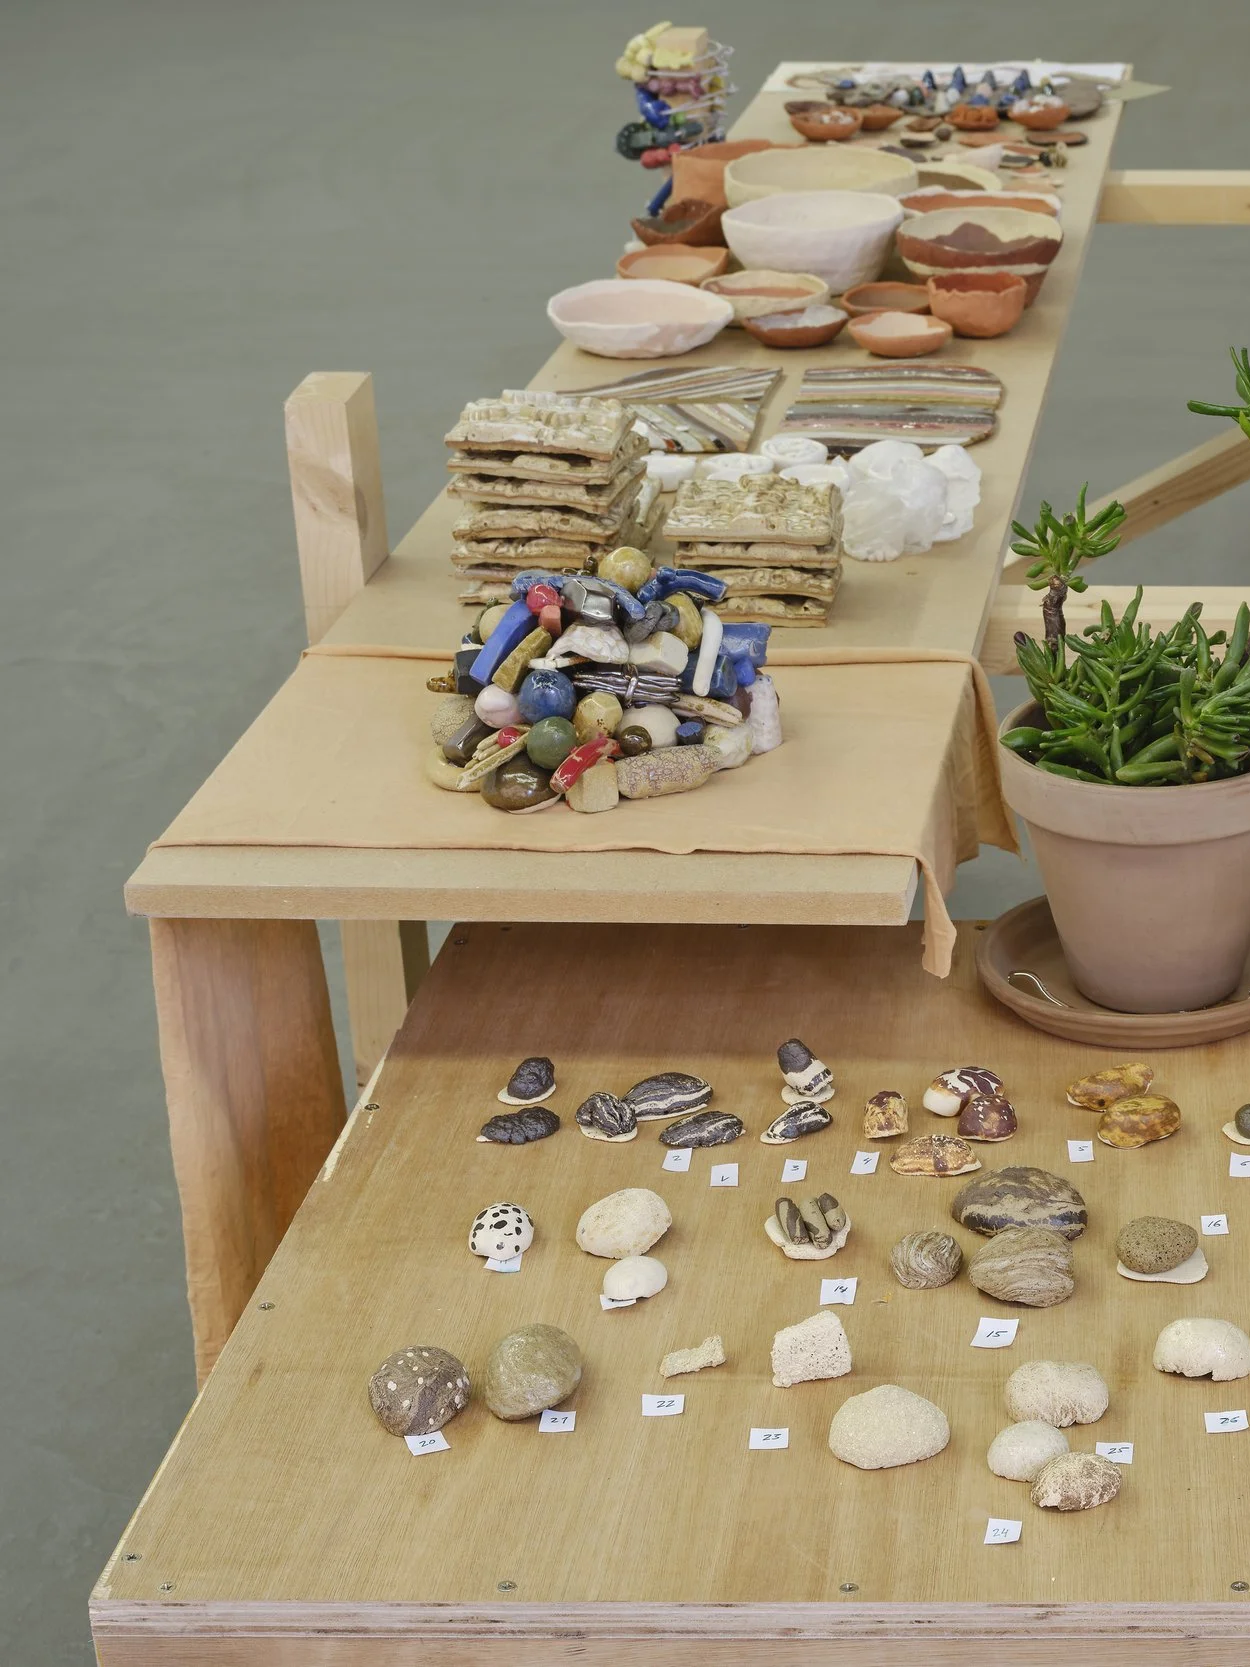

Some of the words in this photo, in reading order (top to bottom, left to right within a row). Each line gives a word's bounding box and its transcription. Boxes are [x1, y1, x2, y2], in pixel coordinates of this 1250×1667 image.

[1208, 1219, 1222, 1228] 16
[986, 1330, 1008, 1338] 15
[656, 1399, 676, 1408] 22
[762, 1433, 782, 1441] 23
[418, 1438, 436, 1447] 20
[1107, 1446, 1130, 1455] 25
[992, 1527, 1009, 1538] 24
